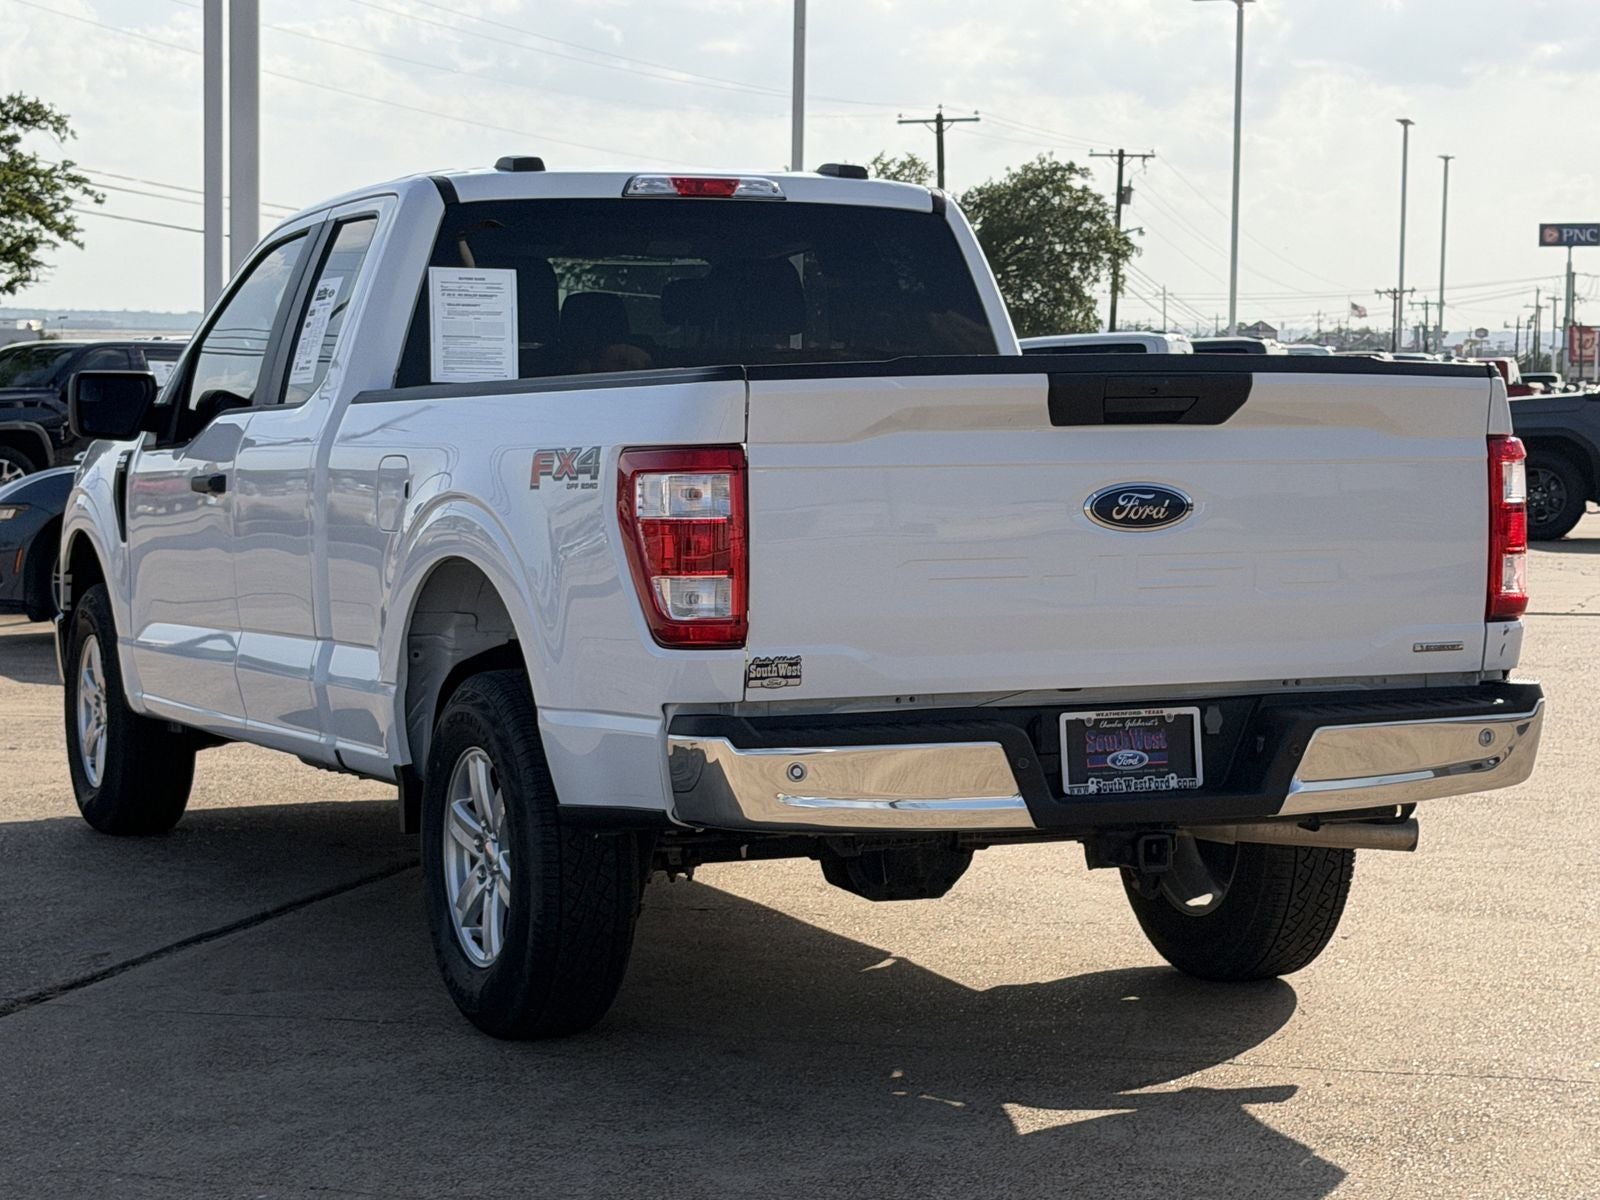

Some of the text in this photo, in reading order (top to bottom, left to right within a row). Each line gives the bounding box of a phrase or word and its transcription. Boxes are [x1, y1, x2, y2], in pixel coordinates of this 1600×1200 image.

[1562, 228, 1598, 242] PNC
[529, 446, 602, 490] FX4
[1112, 493, 1170, 519] Ford
[750, 664, 801, 678] SouthWest
[1086, 729, 1168, 752] SouthWest
[1116, 753, 1139, 767] Ford
